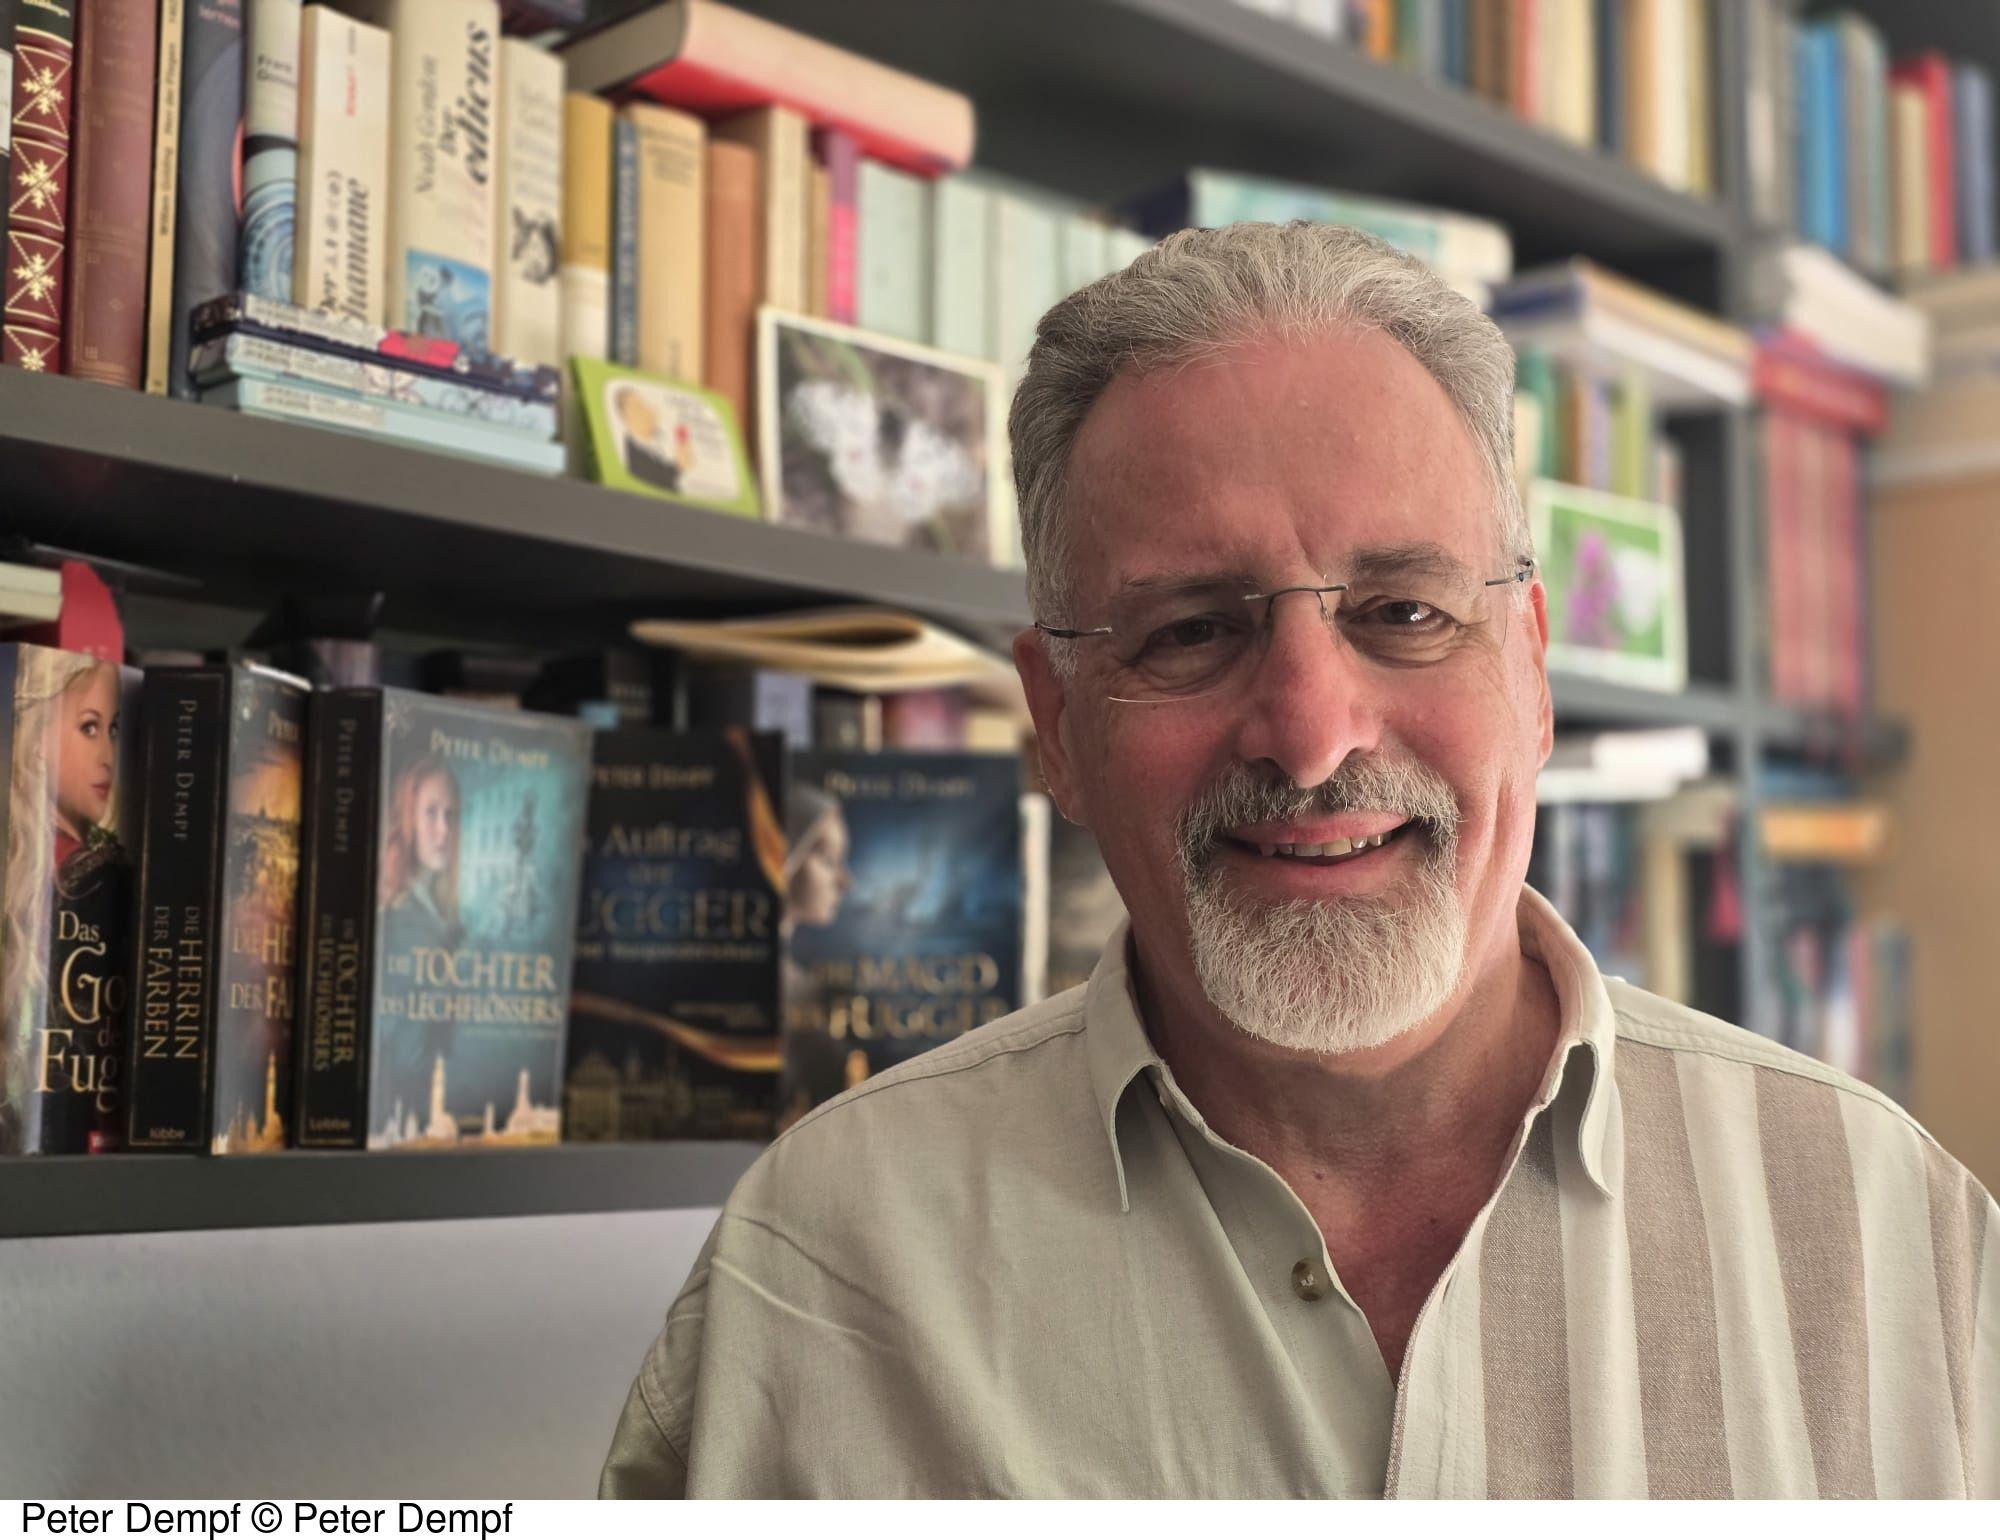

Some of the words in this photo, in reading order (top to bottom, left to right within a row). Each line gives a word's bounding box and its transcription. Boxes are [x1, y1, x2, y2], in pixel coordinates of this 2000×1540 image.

[457, 22, 493, 225] edicus
[176, 700, 197, 760] PETER
[173, 773, 194, 839] DEMPF
[57, 910, 100, 942] Das
[153, 906, 170, 941] DER
[184, 906, 199, 936] DIE
[175, 939, 202, 1059] HERRIN
[410, 944, 557, 992] TOCHTER
[144, 947, 172, 1059] FARBEN
[332, 940, 359, 1065] TOCHTER
